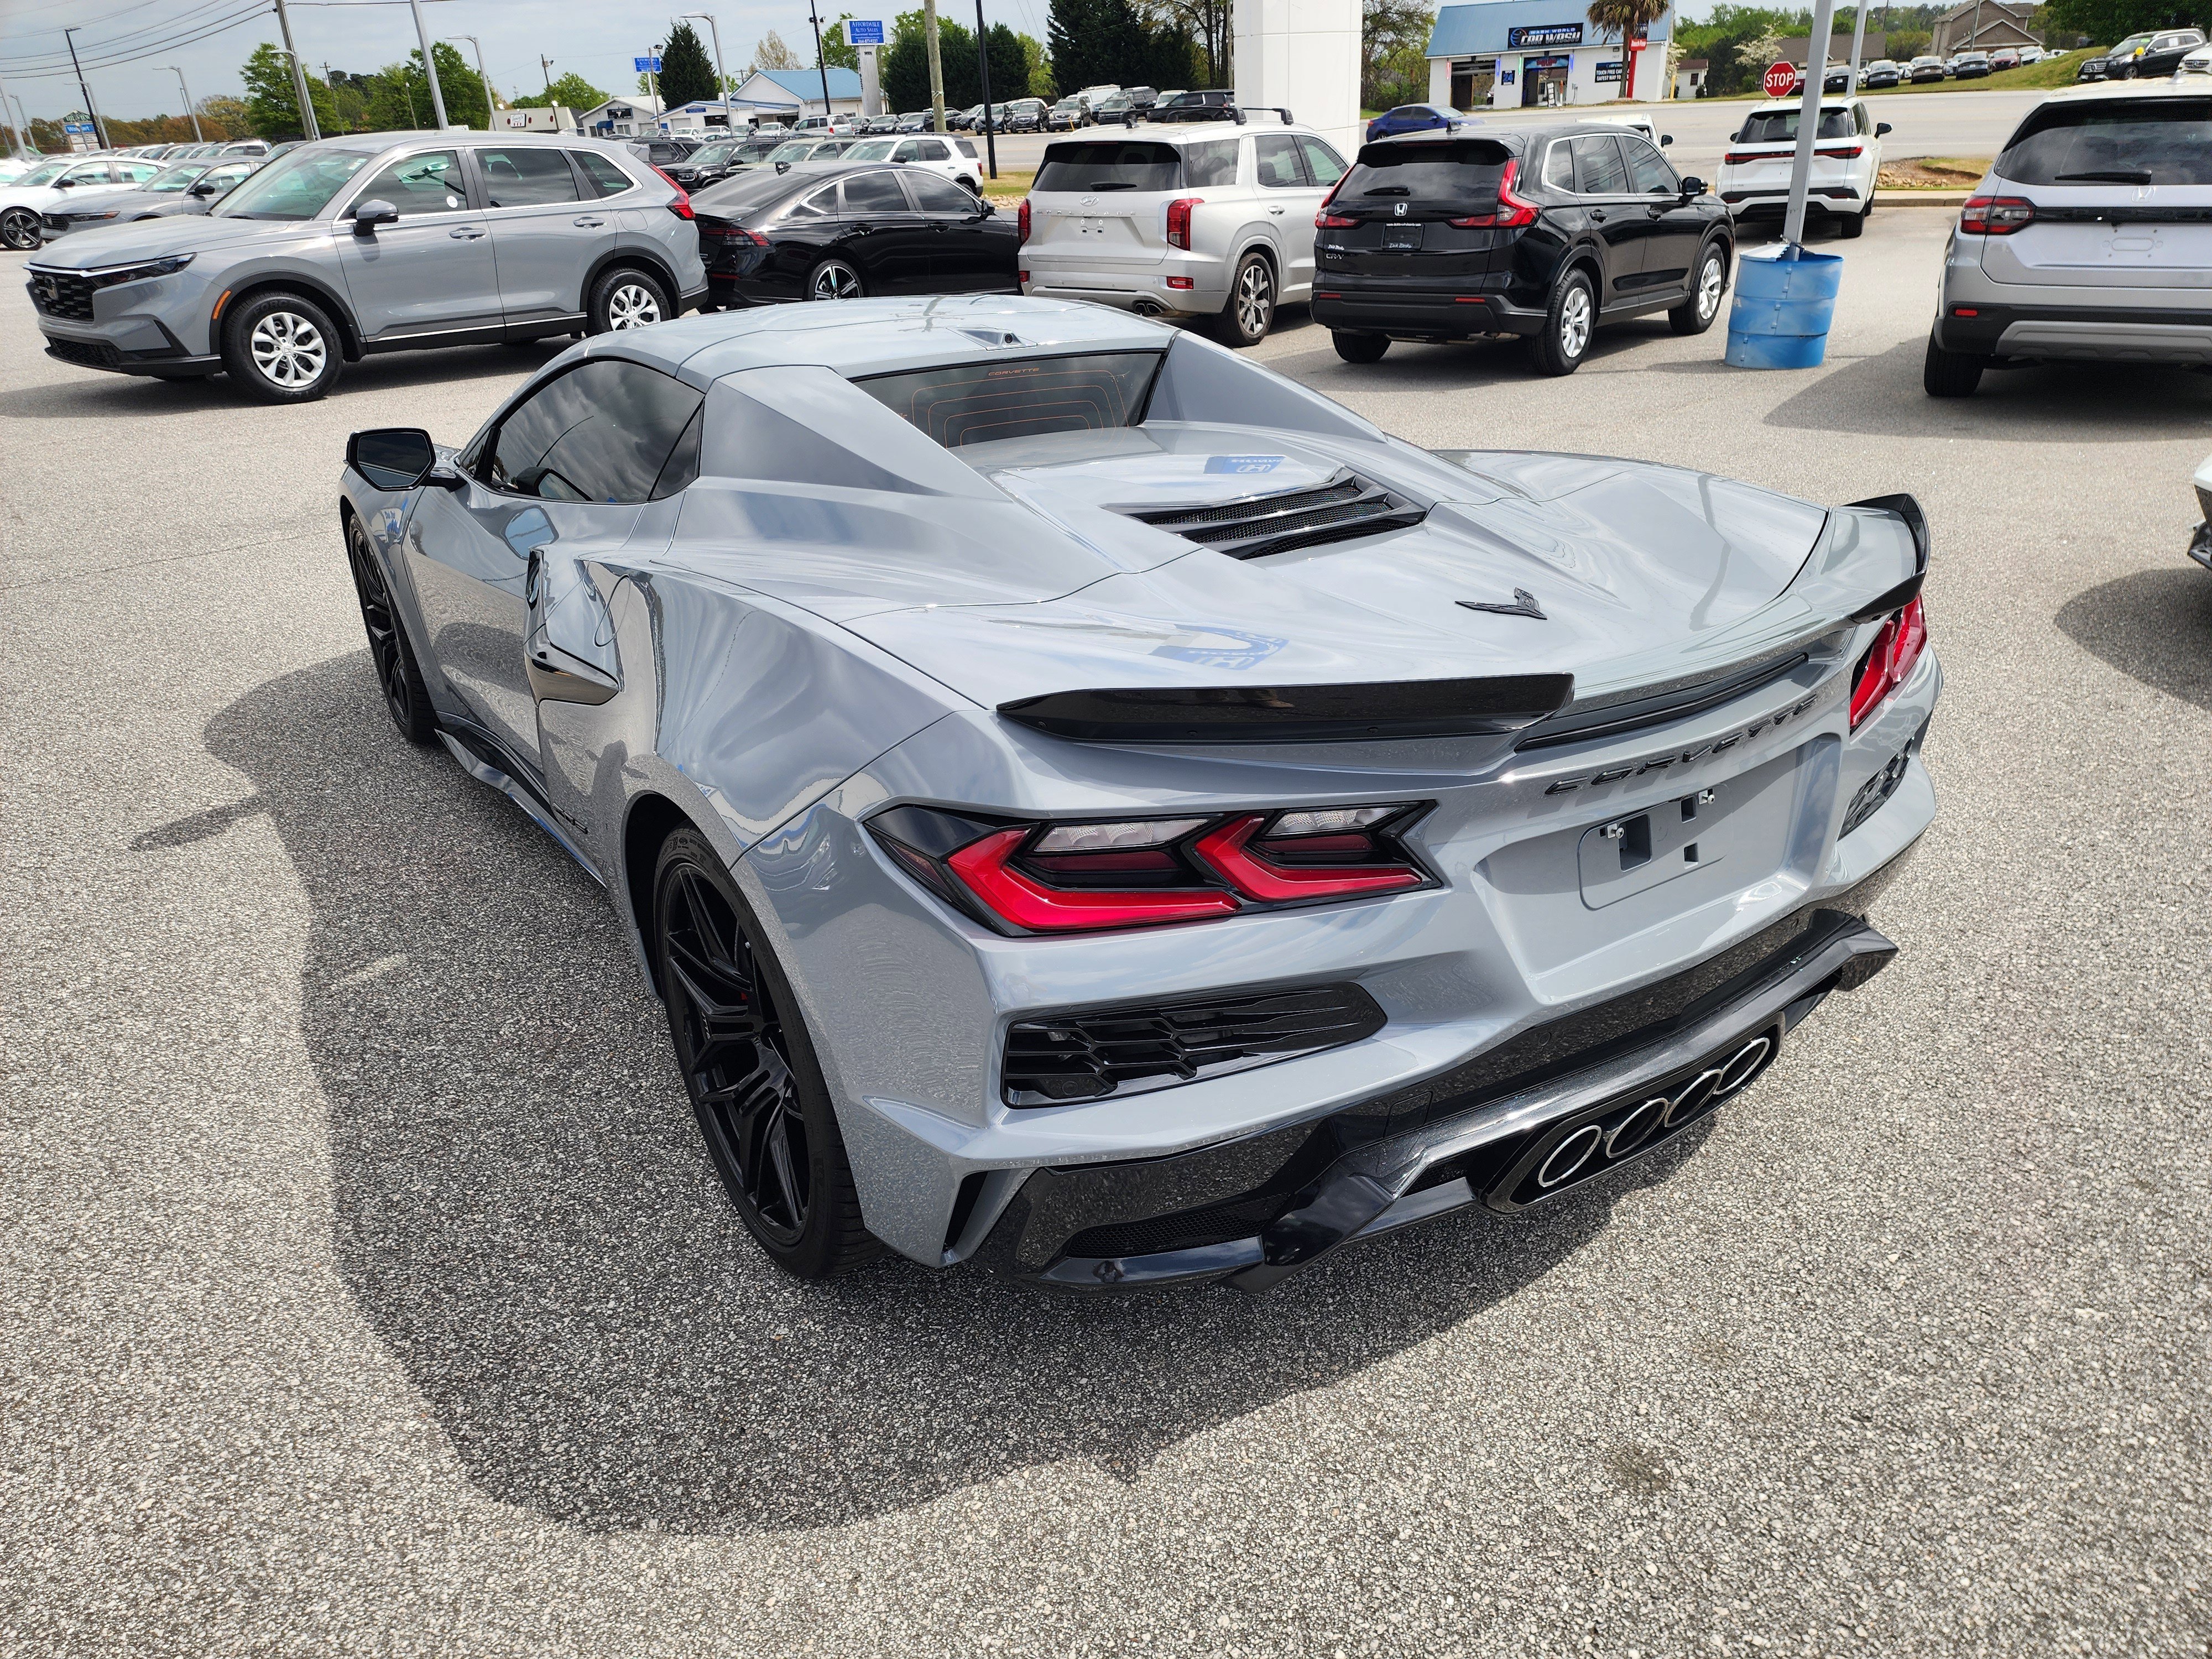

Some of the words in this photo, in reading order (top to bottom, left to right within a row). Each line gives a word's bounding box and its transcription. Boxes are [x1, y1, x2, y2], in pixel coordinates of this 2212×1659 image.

[1520, 34, 1543, 45] CAR
[1546, 32, 1580, 44] WASH
[1766, 72, 1793, 87] STOP
[988, 368, 1040, 376] CORVETTE
[1545, 692, 1818, 795] CORVETTE
